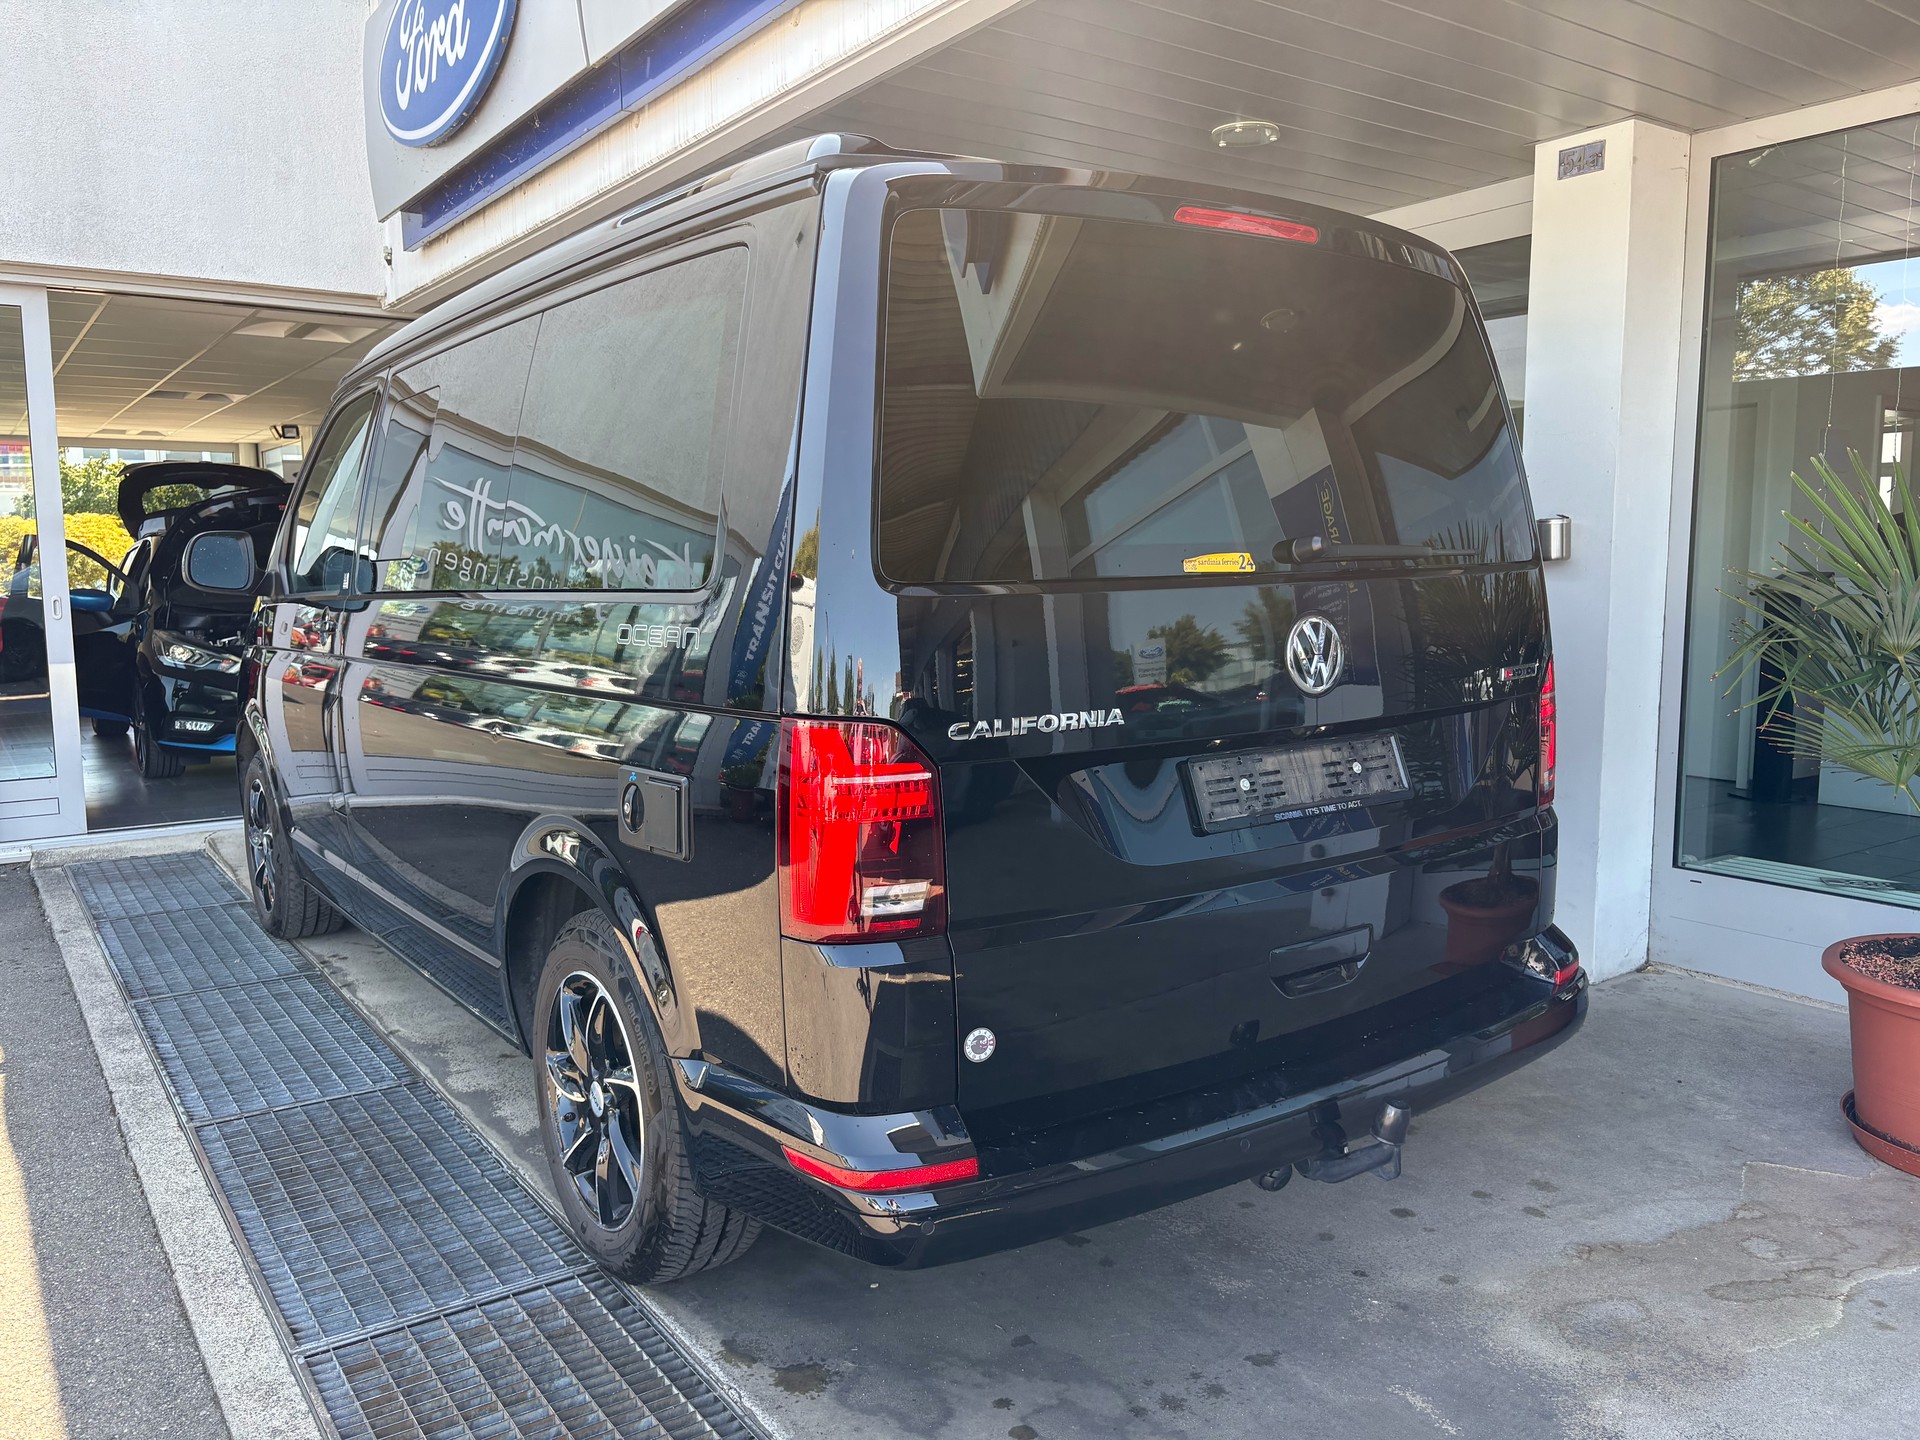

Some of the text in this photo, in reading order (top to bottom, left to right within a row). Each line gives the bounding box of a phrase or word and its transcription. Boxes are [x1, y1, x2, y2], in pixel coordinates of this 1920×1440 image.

[395, 0, 471, 110] Ford
[617, 624, 700, 650] OCEAN
[744, 570, 779, 661] TRANSIT
[948, 708, 1125, 742] CALIFORNIA
[1274, 799, 1363, 821] SCANIA IT'S TIME TO ACT.
[625, 991, 650, 1065] VanContact
